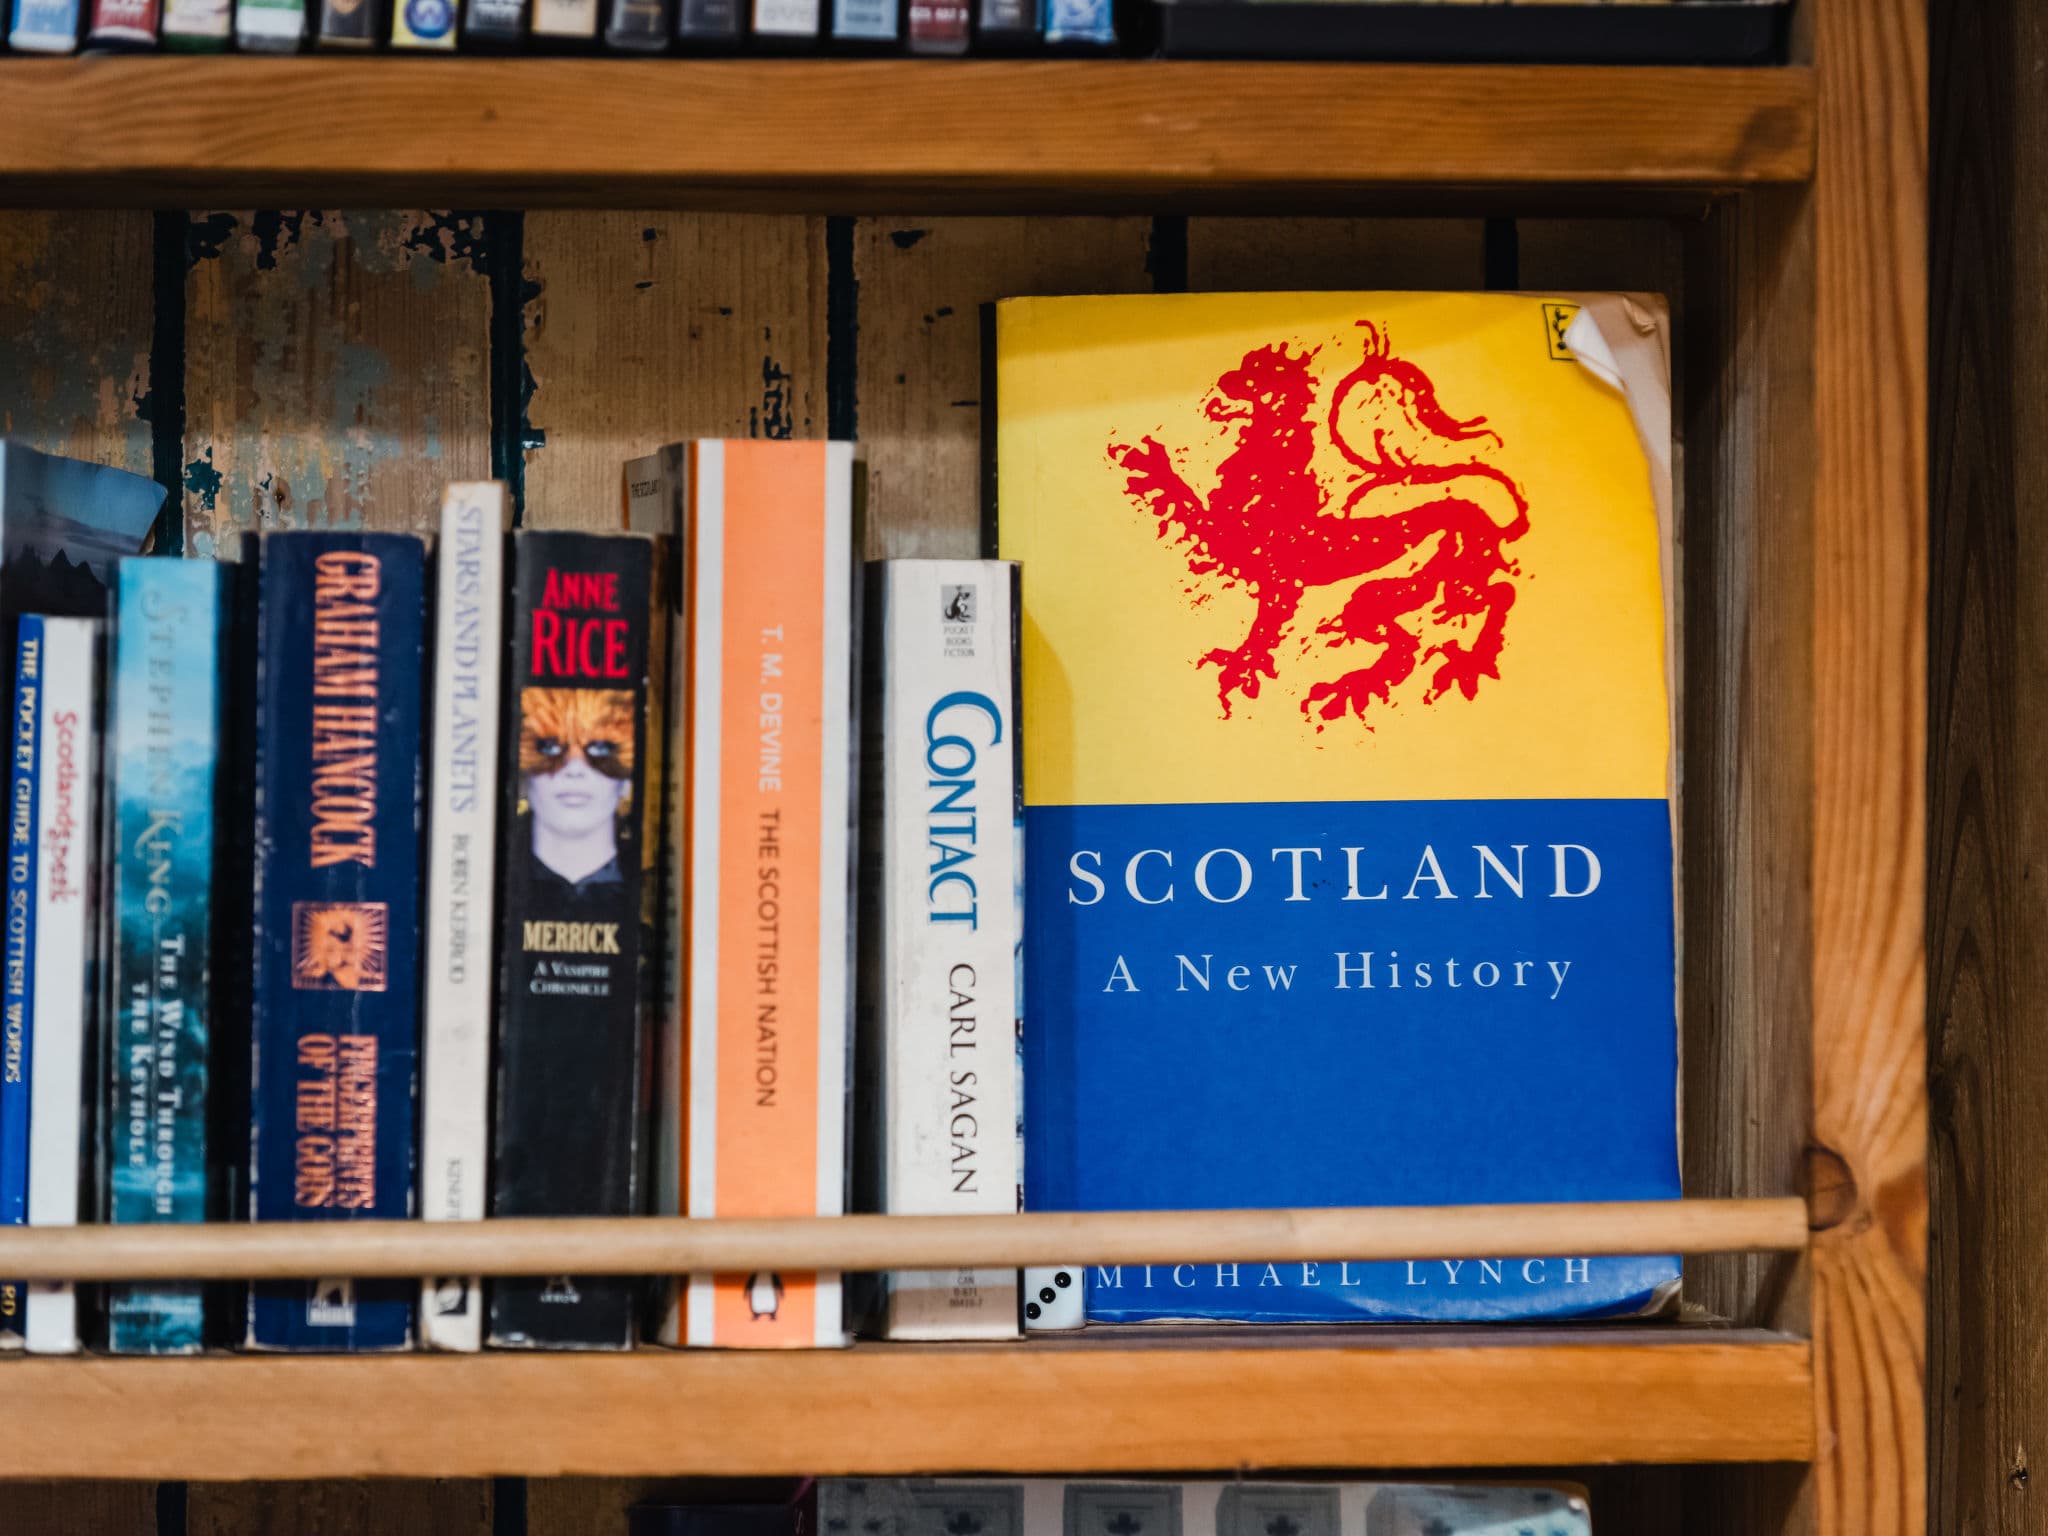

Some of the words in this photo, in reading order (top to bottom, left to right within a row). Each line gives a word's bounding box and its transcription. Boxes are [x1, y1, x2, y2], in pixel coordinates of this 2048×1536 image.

[314, 550, 381, 697] GRAHAM
[541, 567, 619, 612] ANNE
[20, 638, 39, 680] THE
[531, 608, 630, 678] RICE
[760, 653, 783, 686] M.
[761, 624, 784, 645] T.
[17, 686, 36, 773] POCKET
[140, 590, 187, 797] STEPHEN
[759, 693, 783, 793] DEVINE
[13, 777, 32, 846] GUIDE
[310, 705, 378, 869] HANCOCK
[926, 690, 1003, 932] CONTACT
[11, 853, 29, 883] TO
[134, 811, 182, 916] KING
[758, 809, 781, 860] THE
[1068, 844, 1602, 905] SCOTLAND
[8, 889, 28, 996] SCOTTISH
[159, 934, 186, 990] THE
[522, 920, 621, 955] MERRICK
[757, 867, 780, 996] SCOTTISH
[131, 981, 150, 1035] THE
[949, 963, 977, 1059] CARL
[1102, 954, 1142, 993] A
[1174, 953, 1299, 992] New
[1333, 950, 1573, 1001] History
[5, 1003, 23, 1083] WORDS
[158, 999, 184, 1078] WIND
[296, 1033, 337, 1074] OF
[755, 1003, 778, 1107] NATION
[128, 1045, 154, 1169] KEYHOLE
[296, 1080, 337, 1131] THE
[337, 1034, 378, 1209] FINGERPRINTS
[950, 1071, 979, 1194] SAGAN
[155, 1086, 183, 1215] THROUGH
[294, 1135, 337, 1208] GODS
[1095, 1262, 1361, 1289] MICHAEL
[1406, 1259, 1592, 1287] LYNCH
